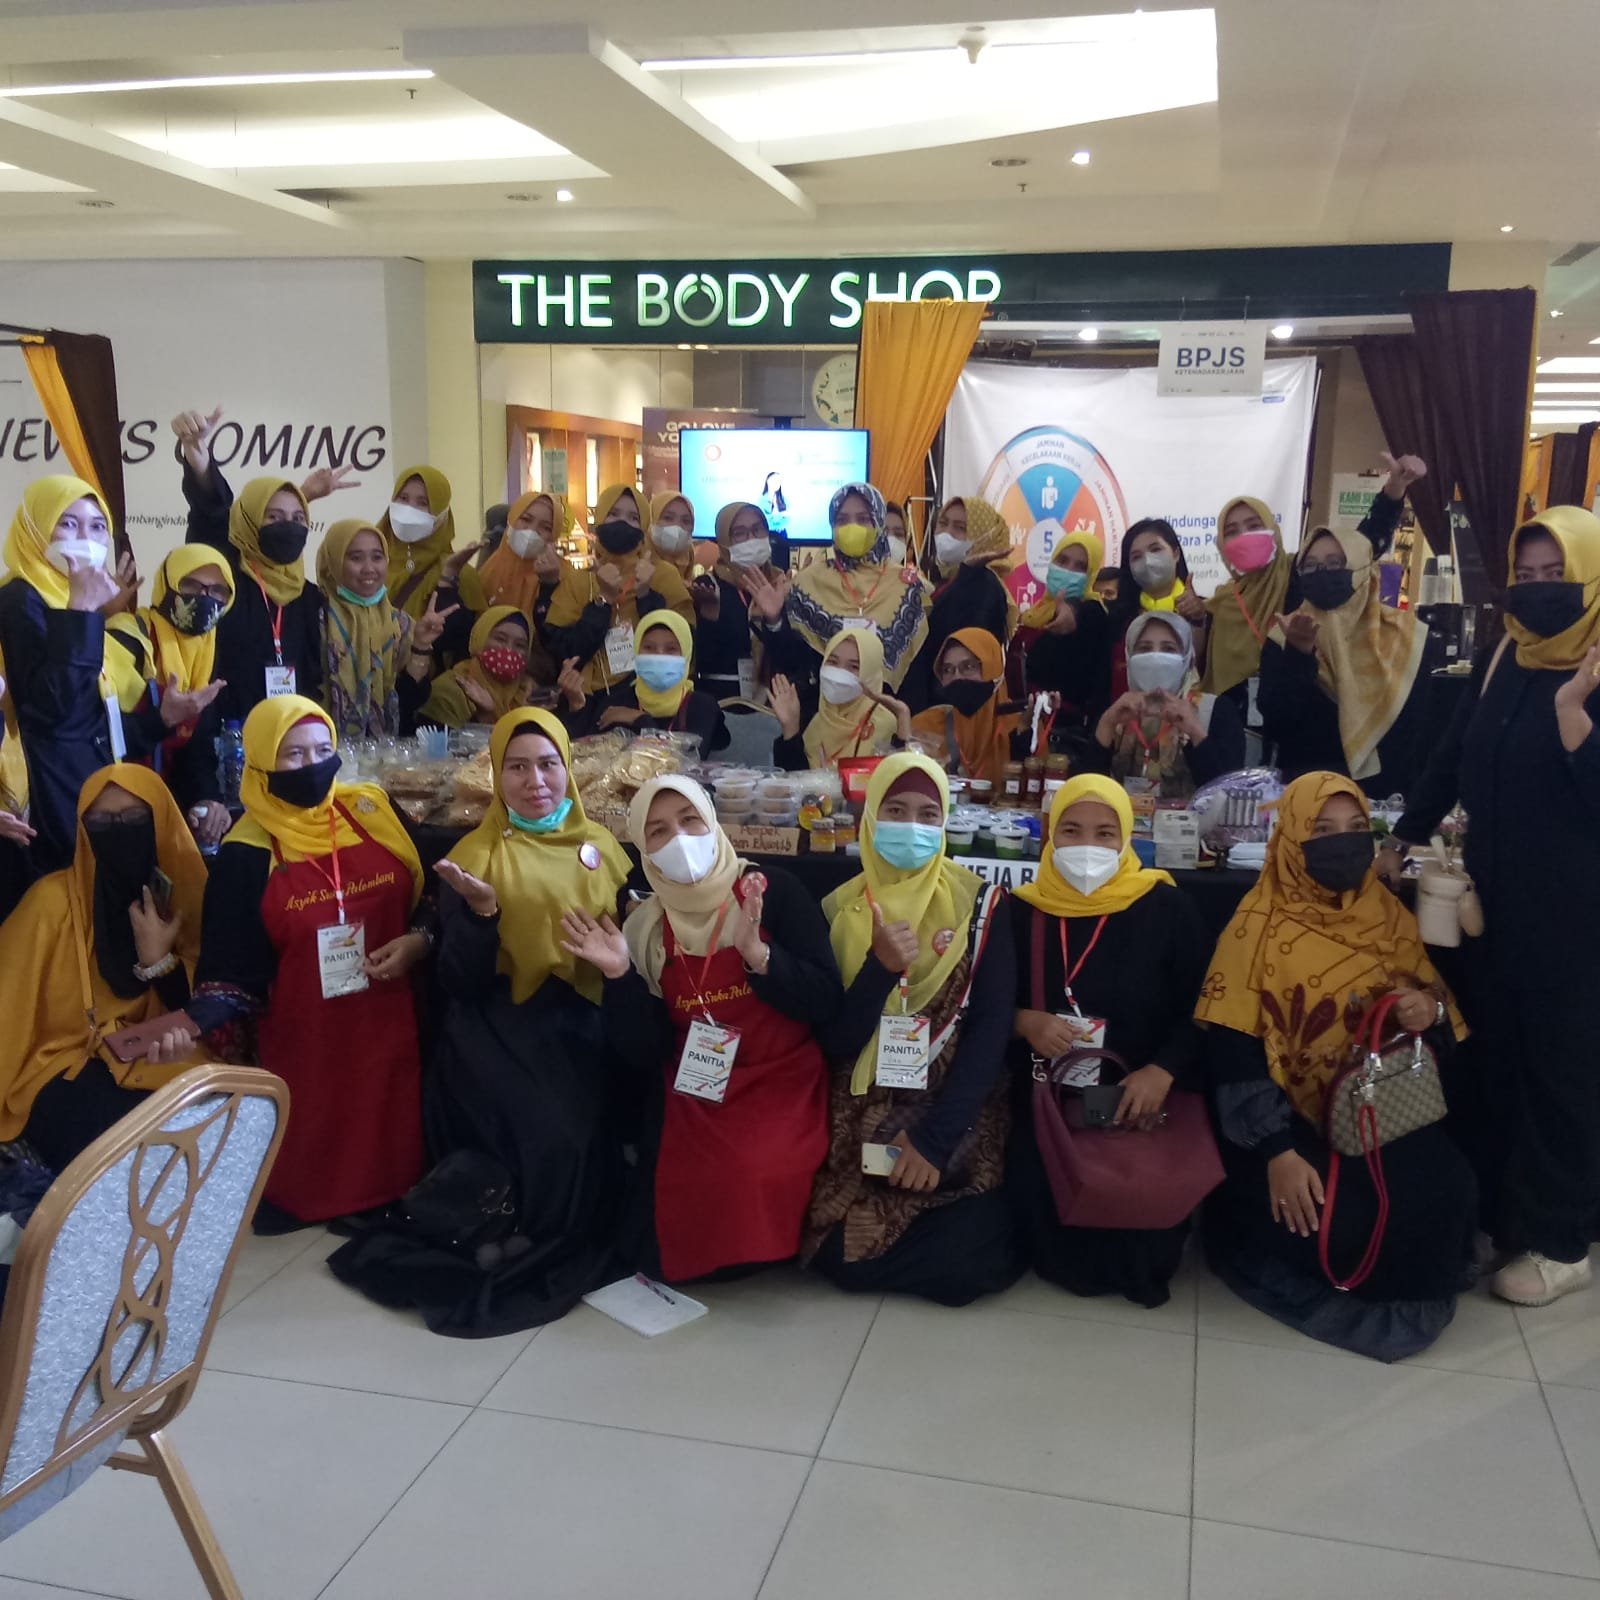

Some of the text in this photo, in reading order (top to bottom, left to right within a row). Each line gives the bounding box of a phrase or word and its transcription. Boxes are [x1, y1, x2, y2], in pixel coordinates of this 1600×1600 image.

[497, 273, 614, 327] THE
[637, 273, 810, 328] BODY
[1176, 346, 1246, 368] BPJS
[119, 420, 386, 472] S OMING
[657, 431, 679, 444] YO
[1163, 514, 1217, 529] lindunga
[1043, 531, 1054, 554] 5
[960, 863, 1013, 891] EJA
[324, 949, 360, 964] PANITIA
[729, 980, 753, 1000] Pale
[687, 1050, 726, 1071] PANITIA
[883, 1045, 922, 1056] PANITIA
